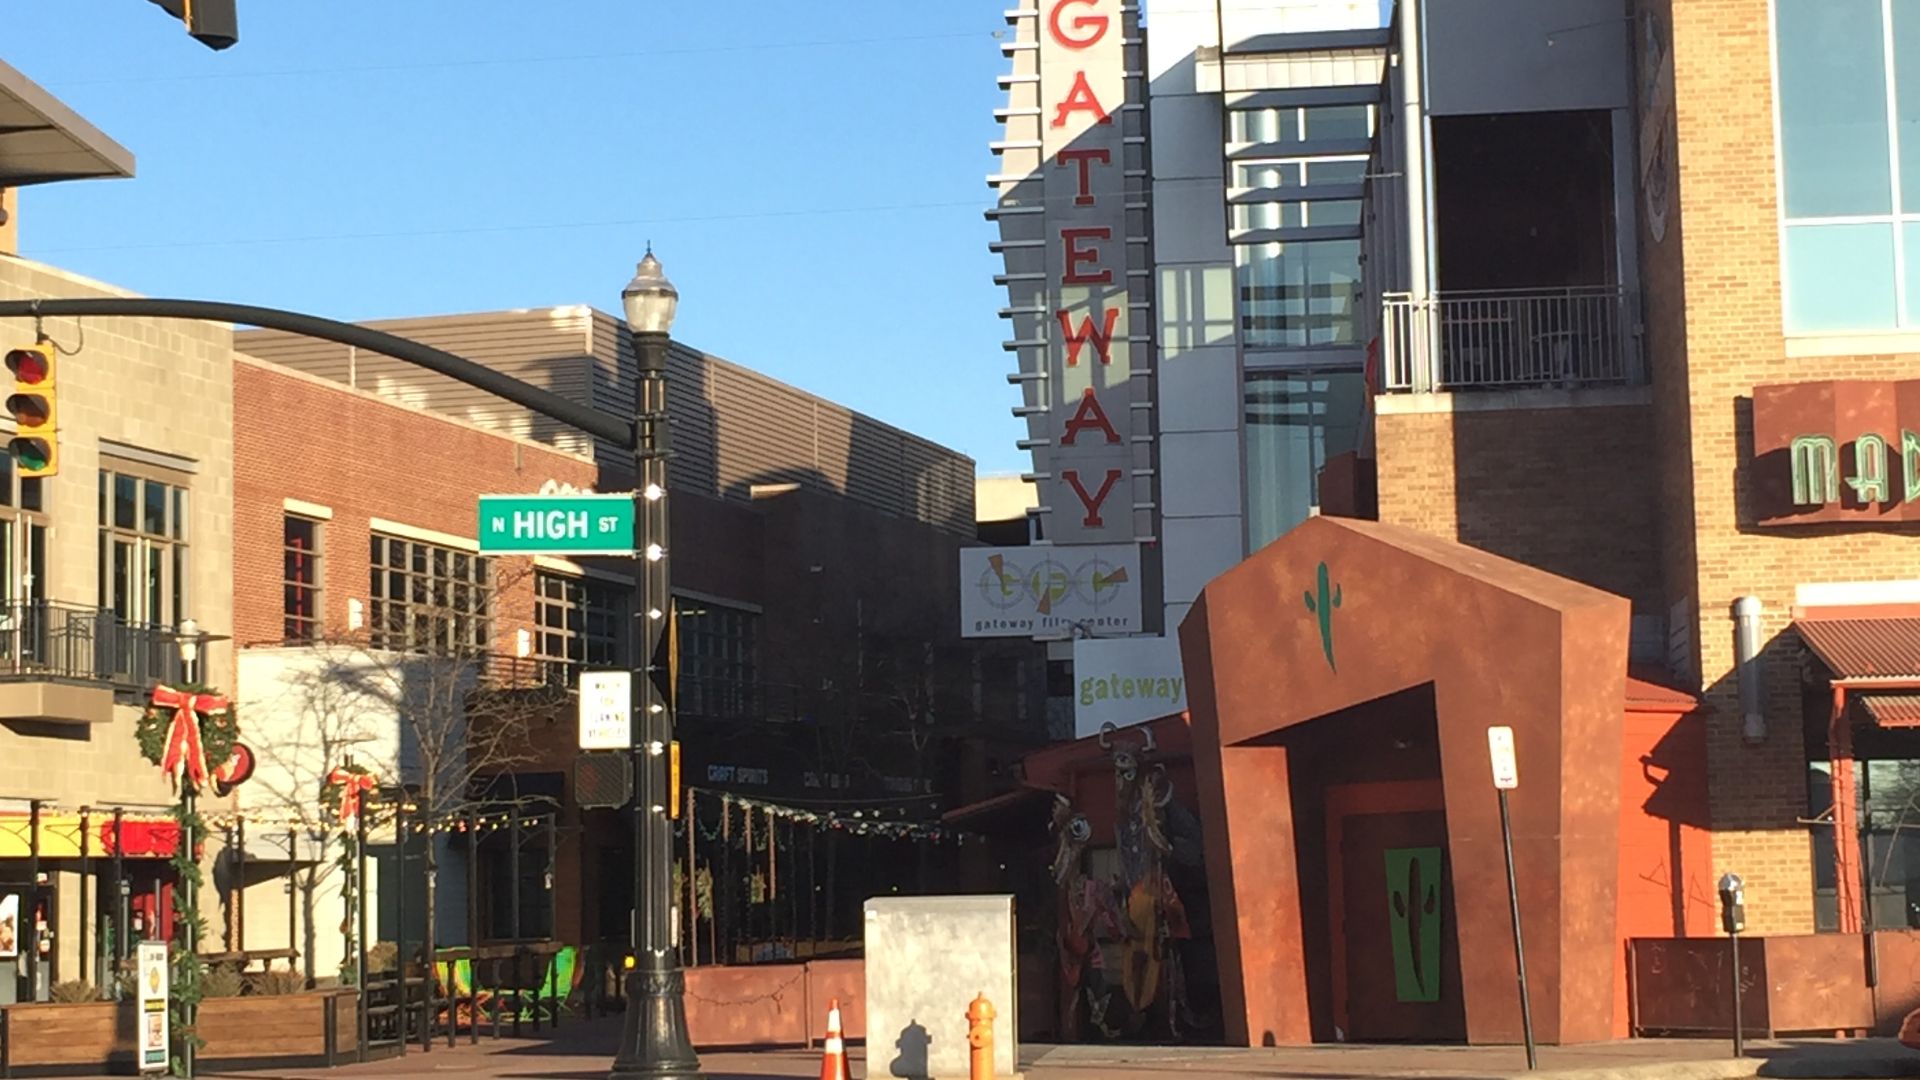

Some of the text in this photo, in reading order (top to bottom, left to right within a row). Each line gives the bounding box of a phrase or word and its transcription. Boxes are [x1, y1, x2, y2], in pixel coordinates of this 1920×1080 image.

[1049, 0, 1122, 527] GATEWAY
[492, 510, 618, 540] N HIGH ST
[975, 618, 1034, 632] gateway
[1080, 673, 1182, 706] gateway
